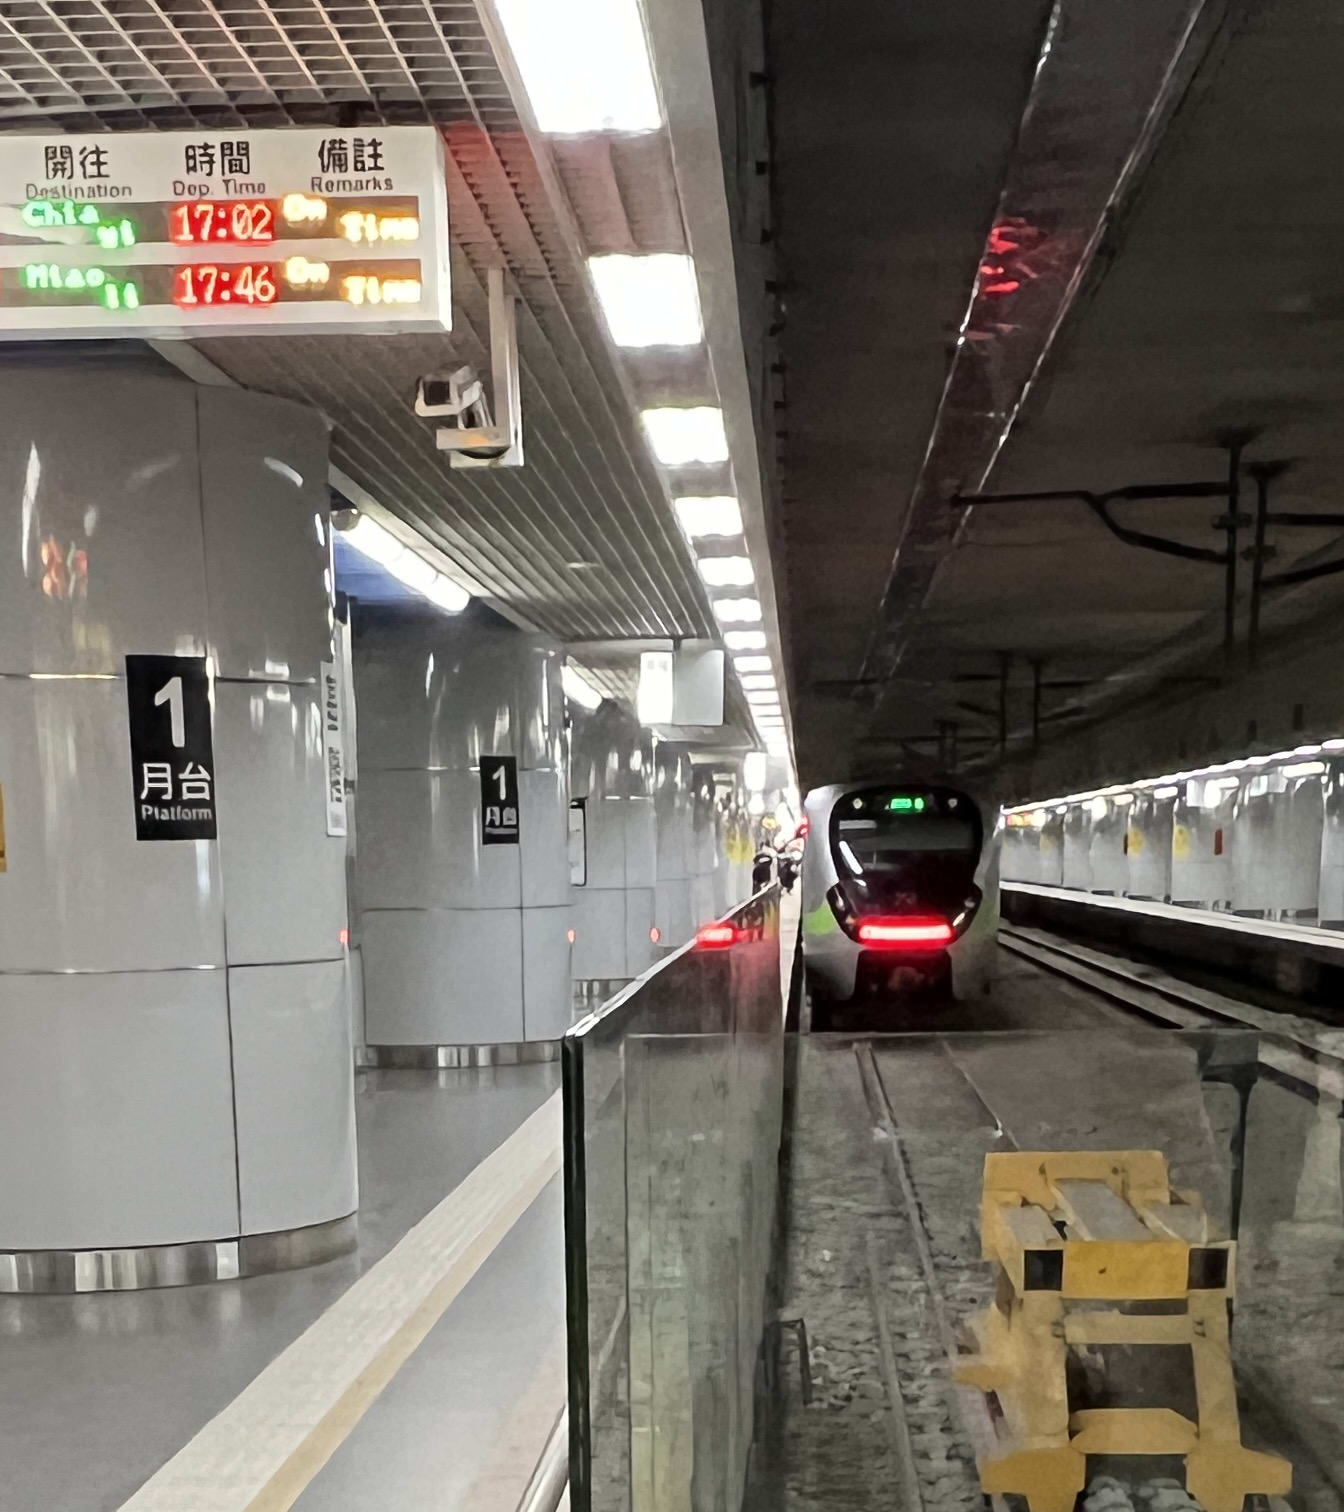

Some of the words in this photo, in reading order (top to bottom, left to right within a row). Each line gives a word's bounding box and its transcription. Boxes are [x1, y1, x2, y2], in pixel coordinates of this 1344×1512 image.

[44, 144, 111, 180] 開往
[185, 141, 250, 176] 時間
[318, 138, 385, 173] 備註
[25, 183, 132, 201] Destination
[223, 179, 266, 196] Time
[311, 176, 393, 192] Remarks
[175, 203, 272, 241] 17:02
[179, 266, 276, 304] 17:46
[154, 676, 186, 748] 1
[141, 761, 212, 801] 月台
[492, 765, 507, 801] 1
[141, 804, 212, 821] Platform
